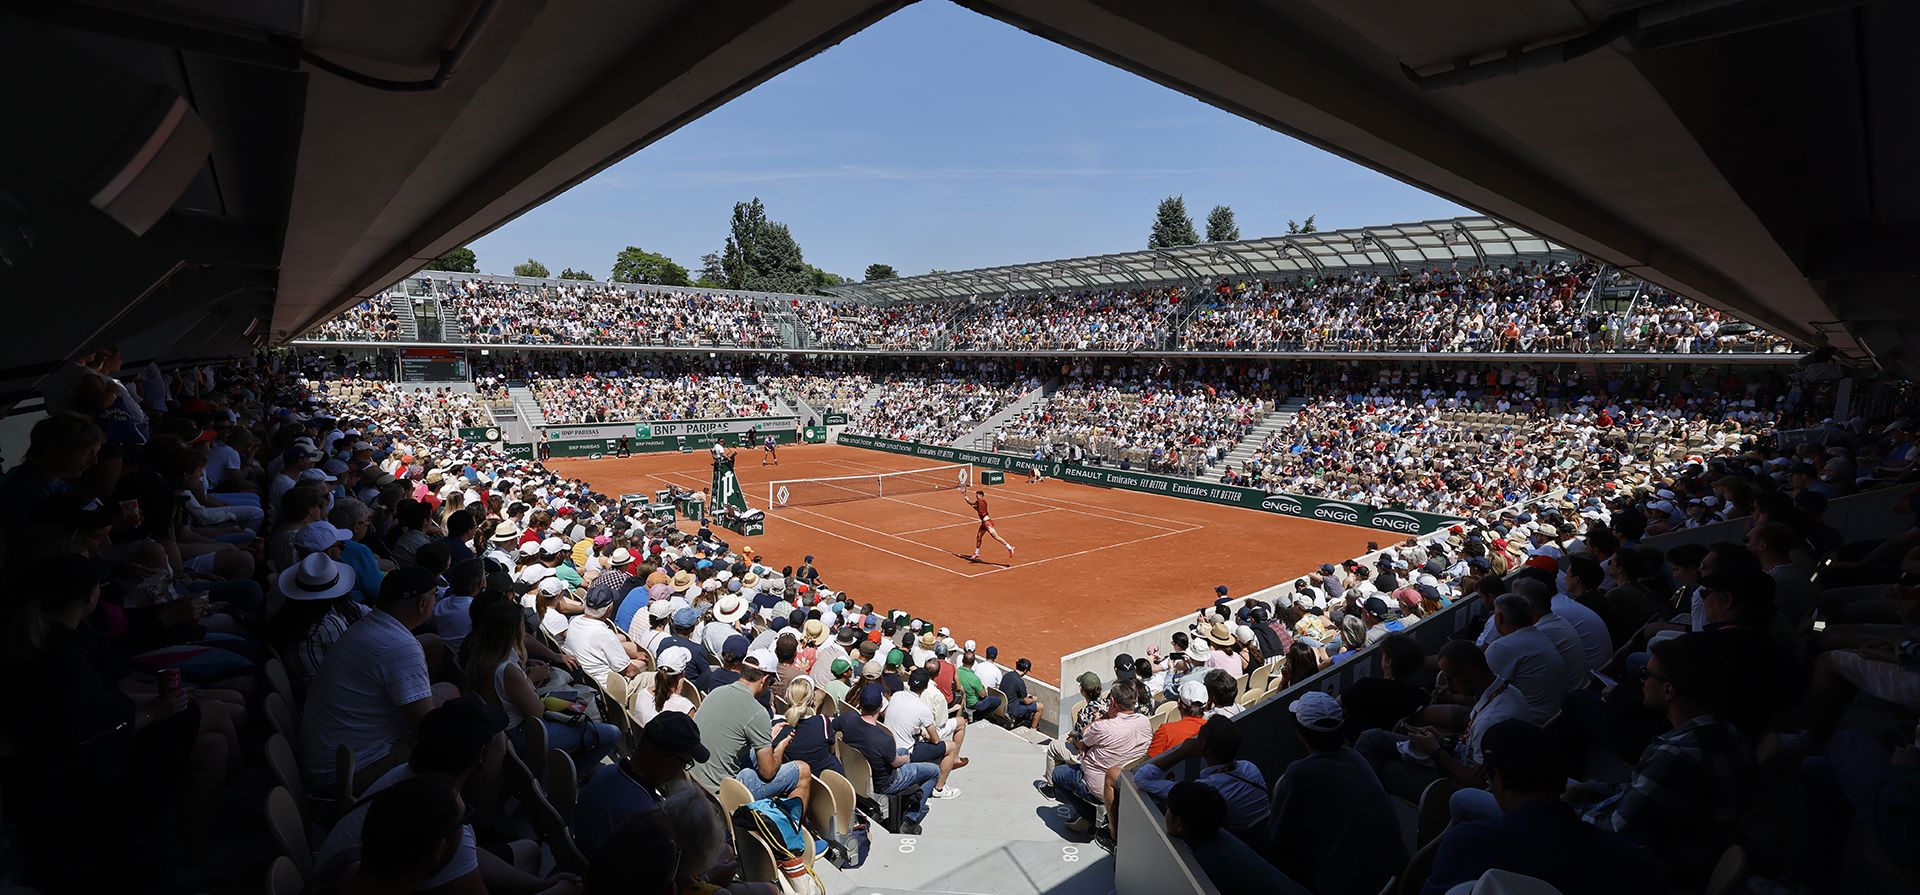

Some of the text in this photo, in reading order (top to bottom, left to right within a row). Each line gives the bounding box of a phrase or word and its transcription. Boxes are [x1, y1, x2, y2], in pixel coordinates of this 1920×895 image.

[654, 425, 677, 435] BNP
[917, 447, 936, 456] Emirates
[959, 453, 980, 462] Emirates
[1015, 461, 1049, 472] RENAULT
[1065, 468, 1102, 480] RENAULT
[1106, 474, 1138, 486] Emirates
[1149, 481, 1168, 491] BETTER
[1172, 483, 1242, 502] Emirates FLY BETTER
[1062, 845, 1079, 862] 08
